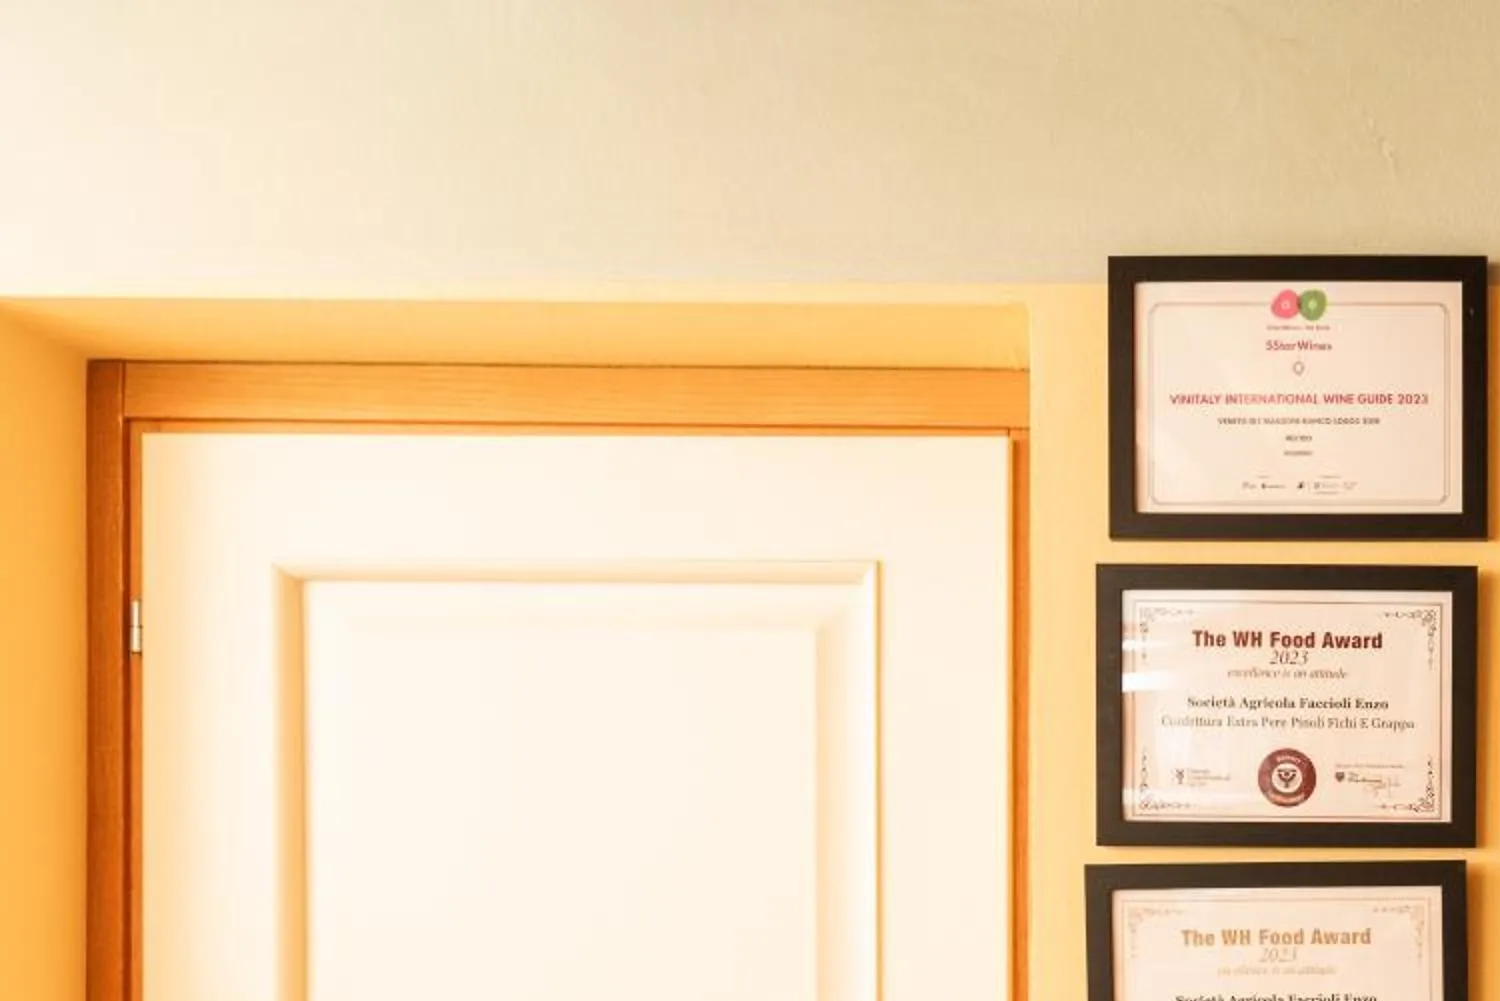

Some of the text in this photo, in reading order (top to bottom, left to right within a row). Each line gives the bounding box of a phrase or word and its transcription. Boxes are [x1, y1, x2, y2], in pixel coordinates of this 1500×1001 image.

[1170, 394, 1428, 404] VINITALY INTERNATIONAL WINE GUIDE 2023
[1192, 630, 1383, 649] The WH Food Award
[1269, 651, 1309, 665] 2023
[1187, 697, 1389, 711] Società Agricola Faccioli Enzo
[1162, 715, 1414, 732] Confettura Extra Pere Pinoli Fichi E Grappa
[1182, 928, 1372, 946] The WH Food Award
[1259, 947, 1299, 963] 2023
